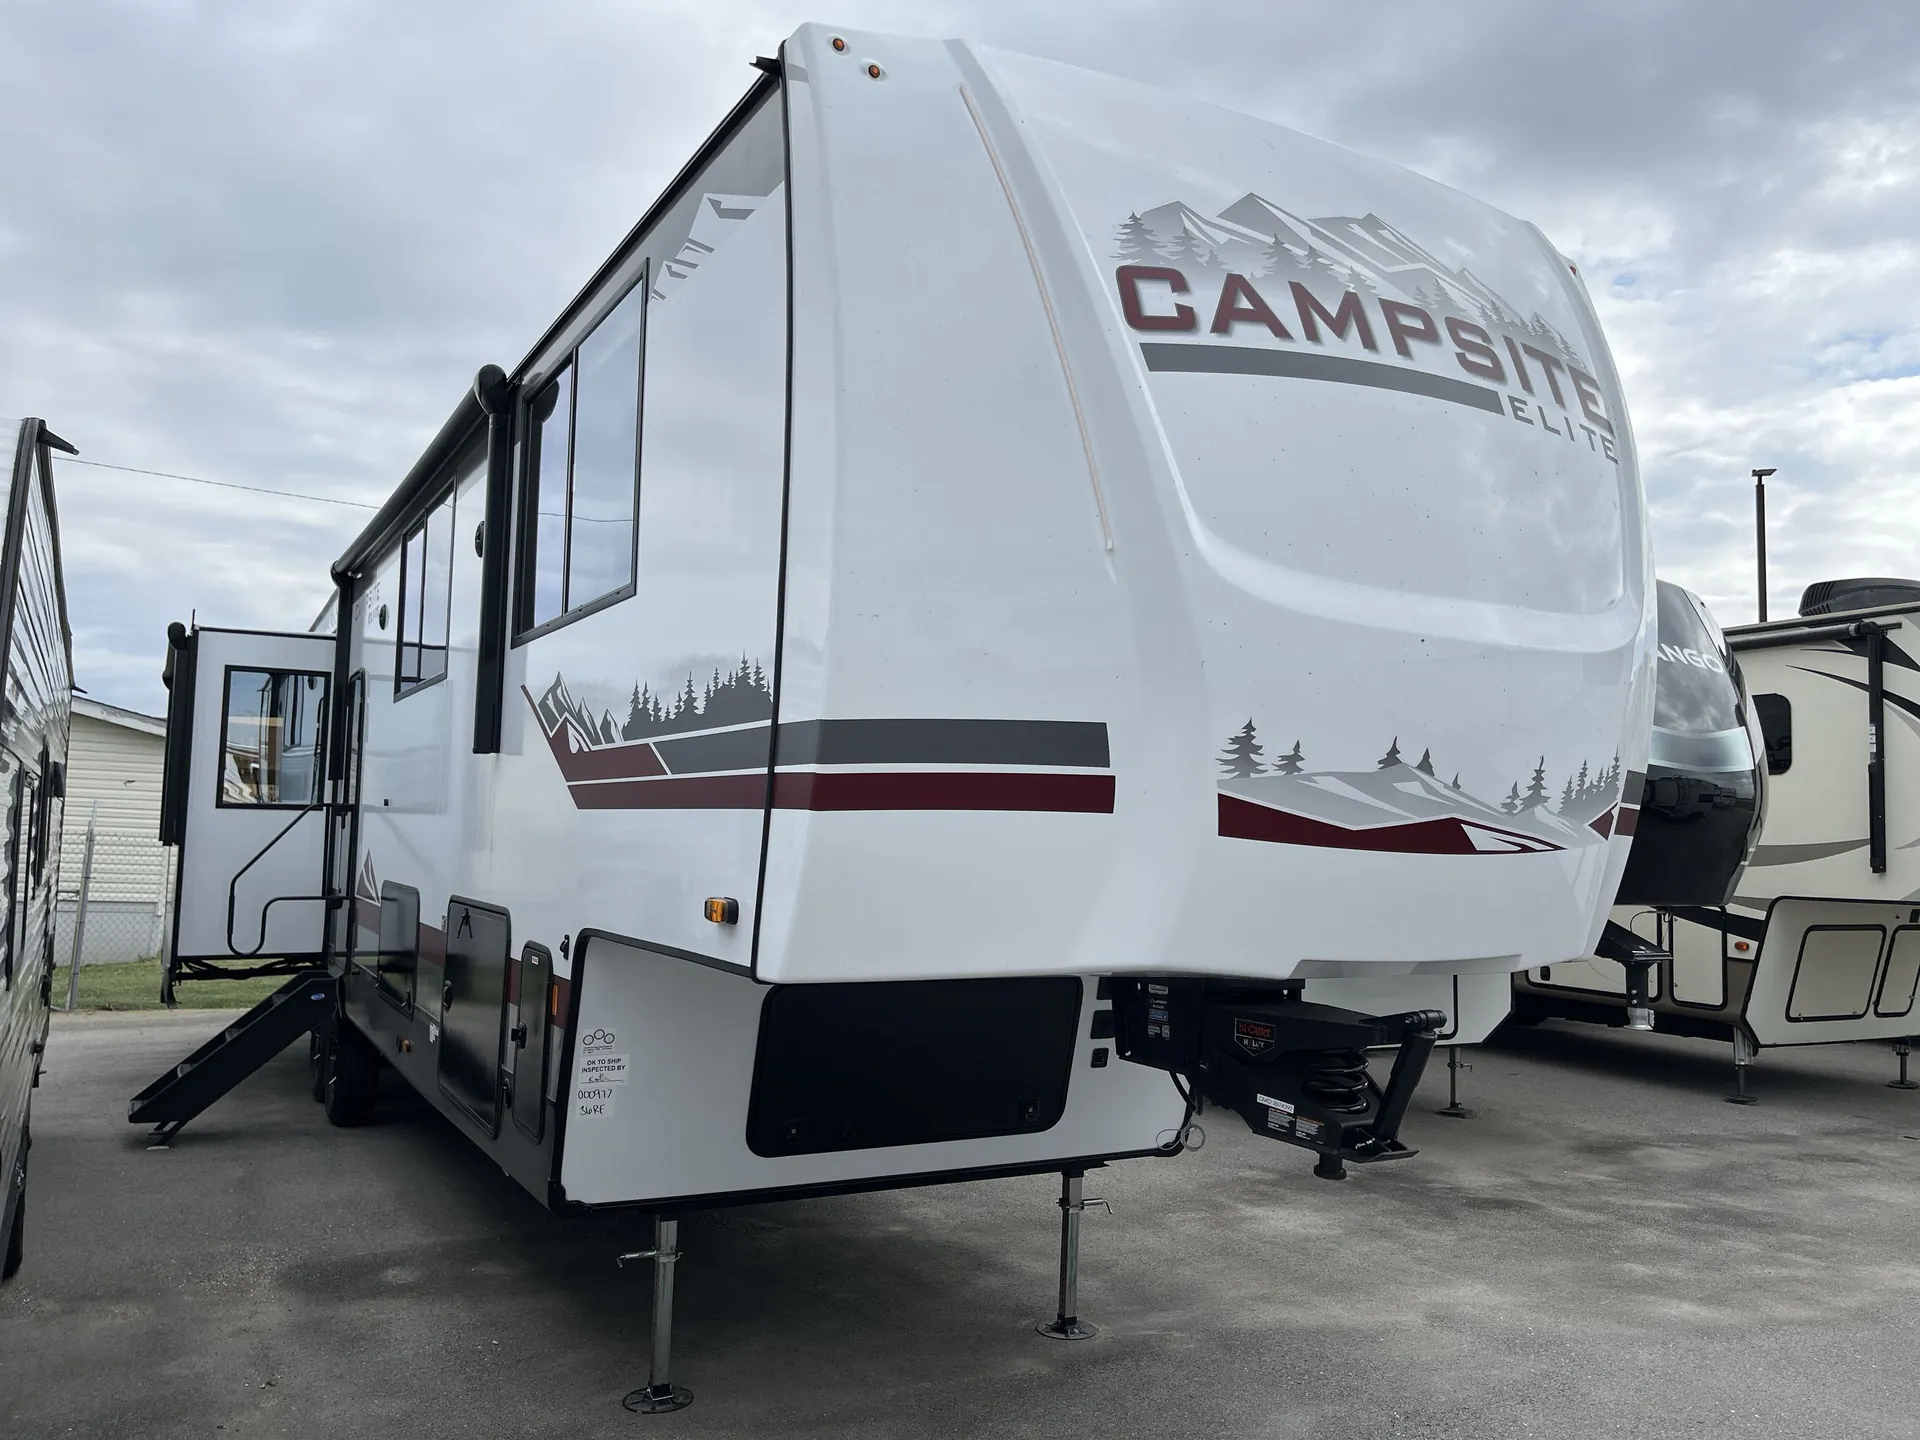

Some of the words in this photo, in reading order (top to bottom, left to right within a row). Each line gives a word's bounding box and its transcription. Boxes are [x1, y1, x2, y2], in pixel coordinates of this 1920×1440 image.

[1116, 264, 1615, 437] CAMPSITE
[1507, 394, 1619, 465] ELITE
[1248, 1024, 1271, 1037] CURT
[582, 1065, 615, 1073] INSPECTED
[578, 1089, 612, 1099] 000977
